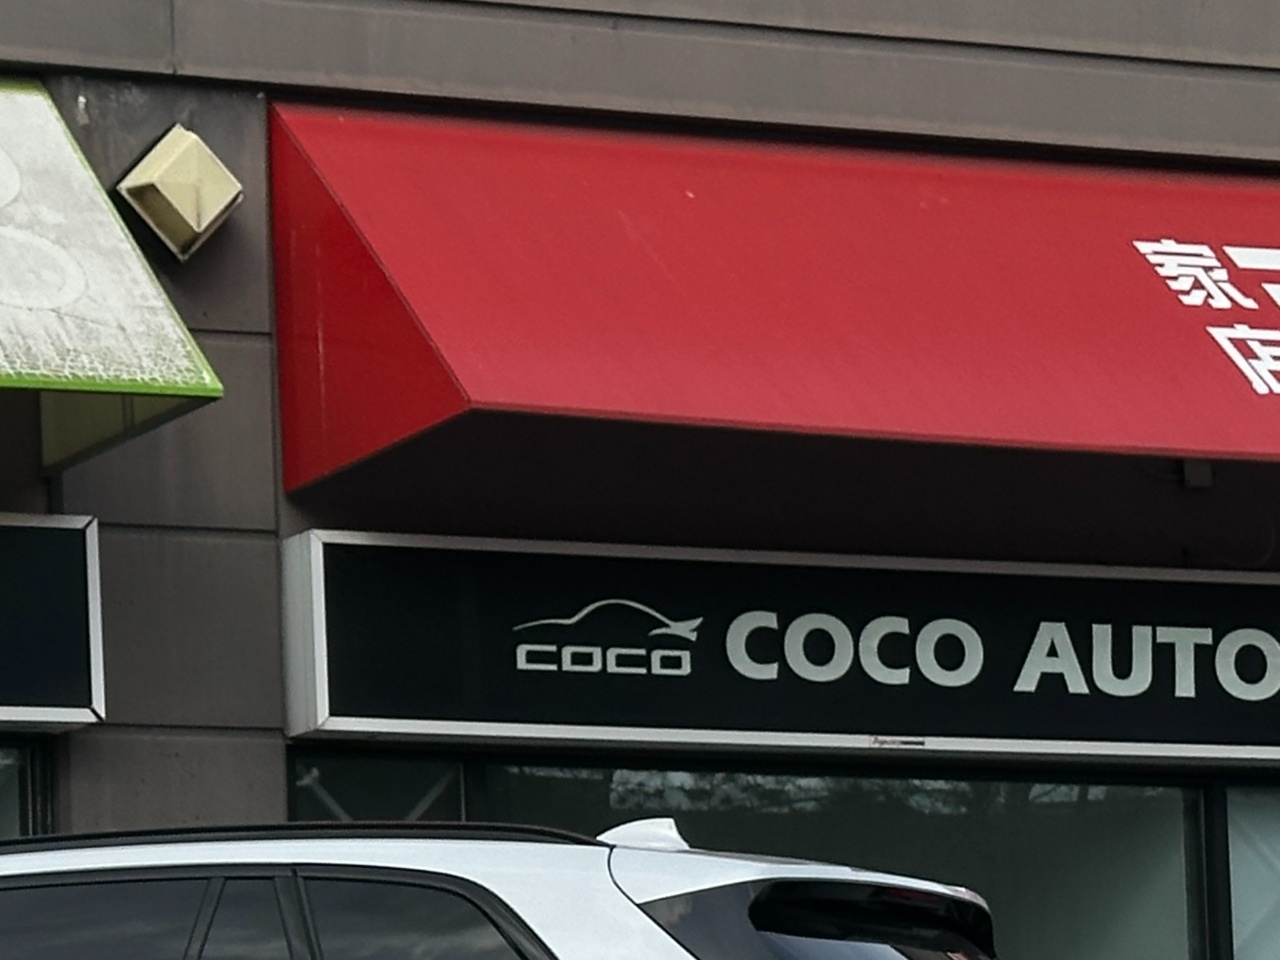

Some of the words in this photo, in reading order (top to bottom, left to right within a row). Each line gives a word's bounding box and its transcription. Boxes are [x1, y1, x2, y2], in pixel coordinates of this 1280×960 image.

[516, 643, 692, 676] COCO
[725, 611, 984, 687] COCO
[1013, 621, 1280, 701] AUTO
